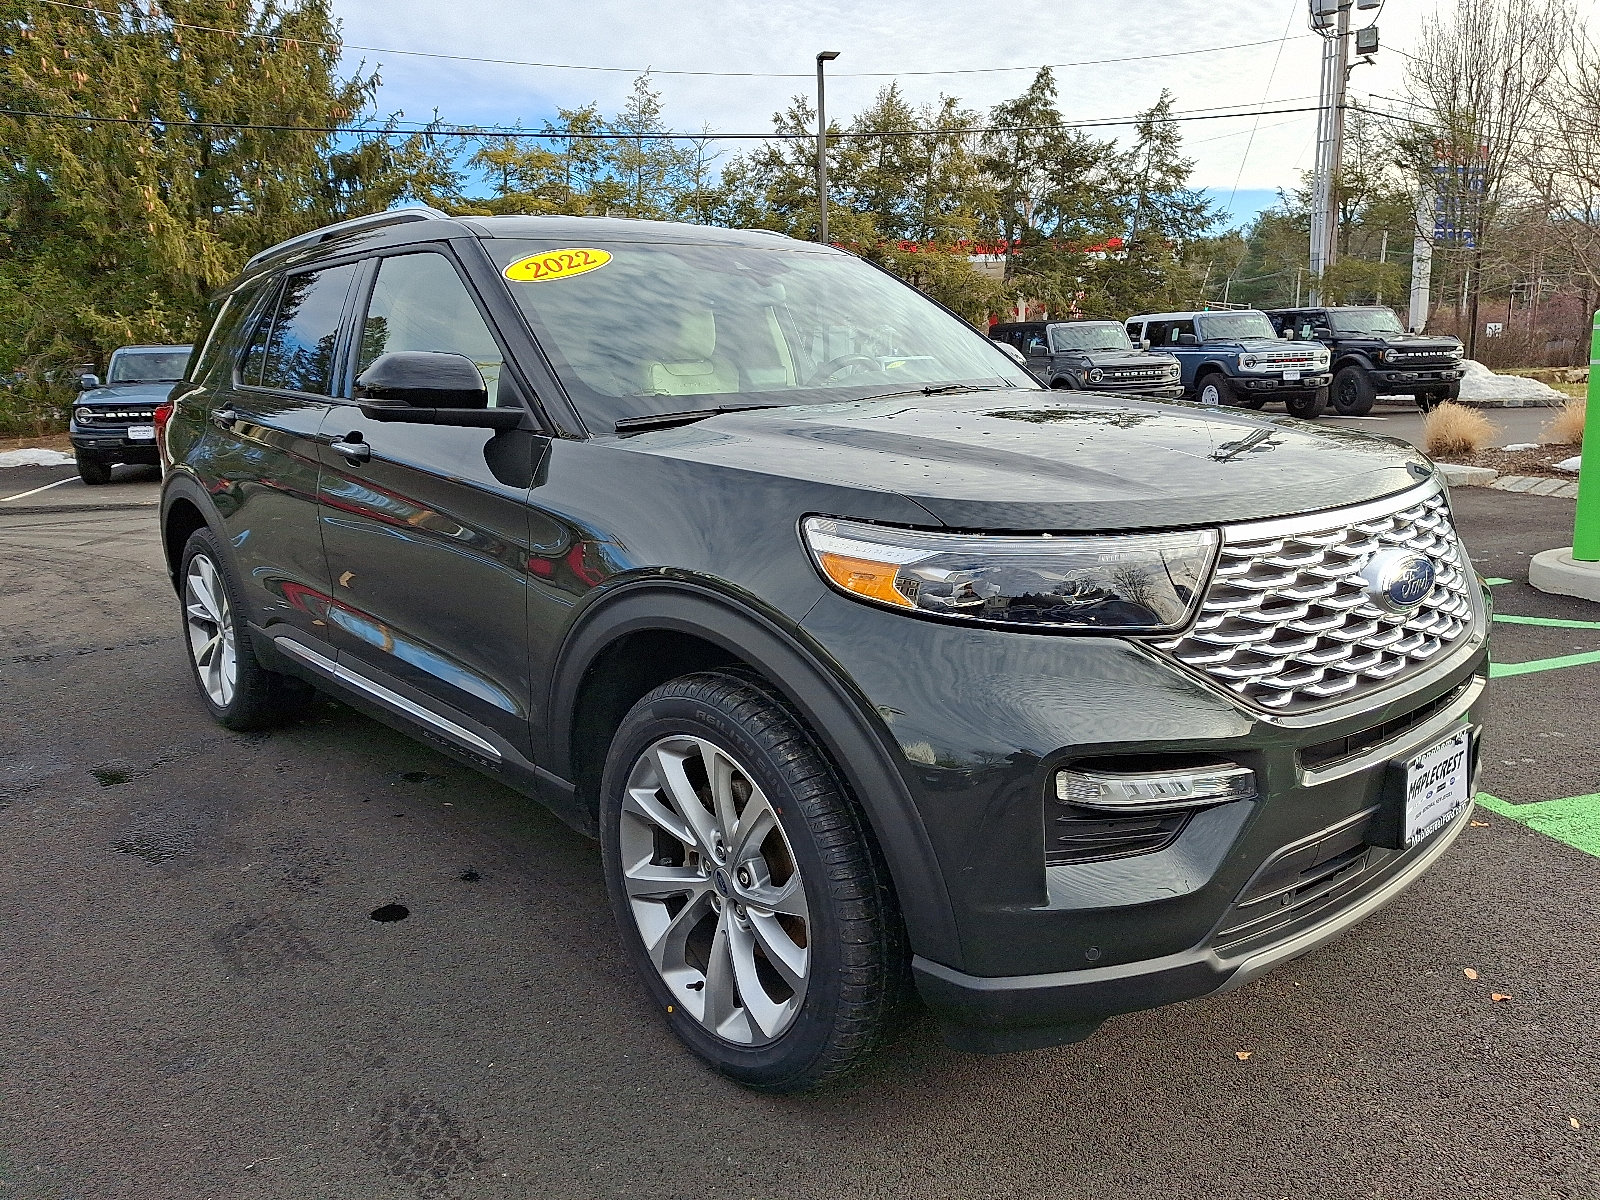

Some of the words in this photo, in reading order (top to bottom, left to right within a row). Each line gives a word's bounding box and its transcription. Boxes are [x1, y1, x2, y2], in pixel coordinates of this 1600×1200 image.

[525, 250, 597, 278] 2022
[1401, 566, 1429, 598] Ford
[1408, 750, 1464, 803] MAPLECREST
